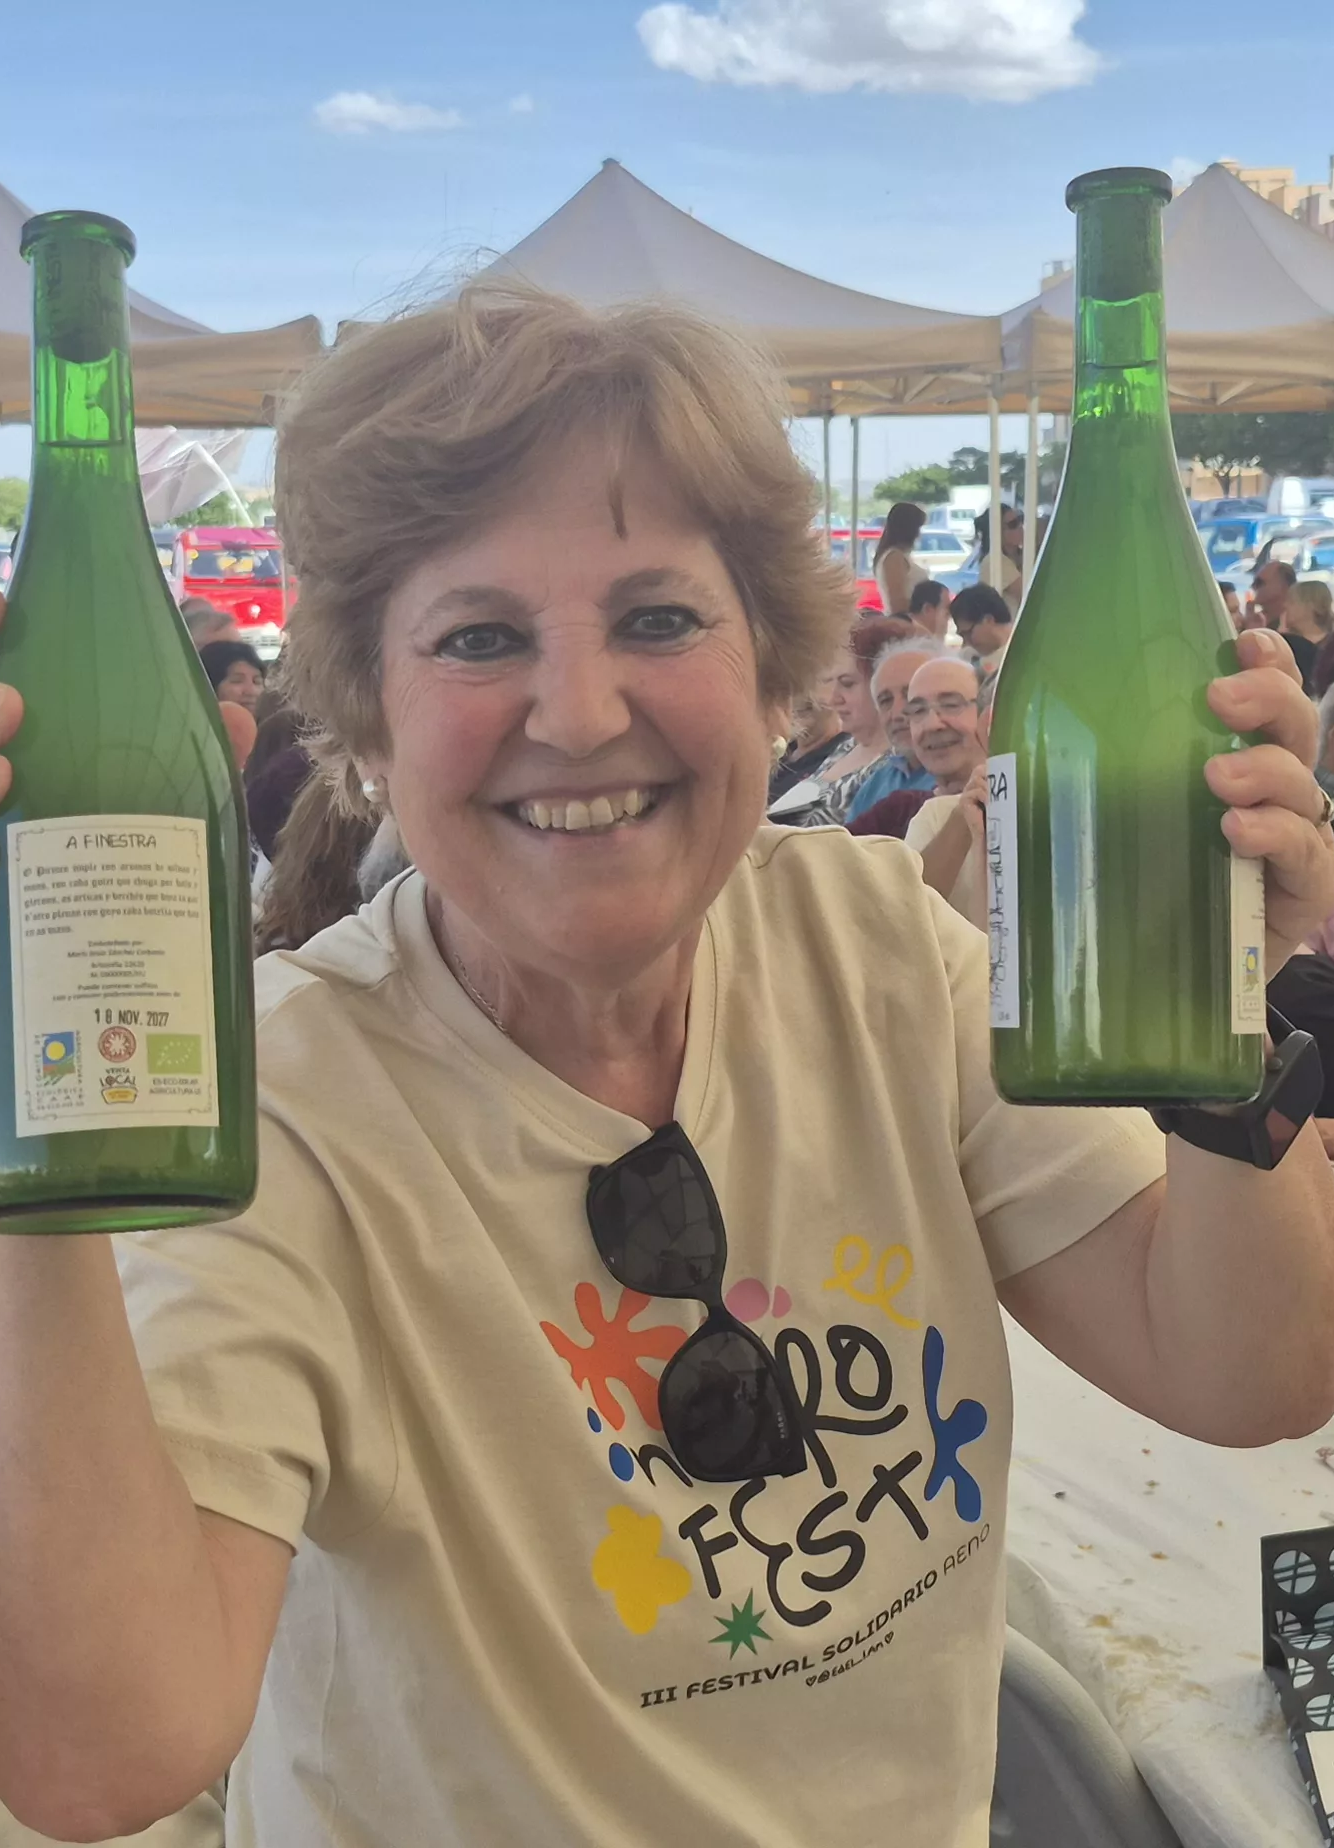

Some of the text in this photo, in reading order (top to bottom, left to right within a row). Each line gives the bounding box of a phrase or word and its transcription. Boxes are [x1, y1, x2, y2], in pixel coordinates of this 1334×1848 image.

[66, 834, 157, 849] A FINESTRA
[118, 1010, 144, 1027] NOV.
[146, 1011, 170, 1027] 2027
[678, 1451, 929, 1627] FEST
[640, 1523, 991, 1709] III FESTIVAL SOLIDARIO AENO
